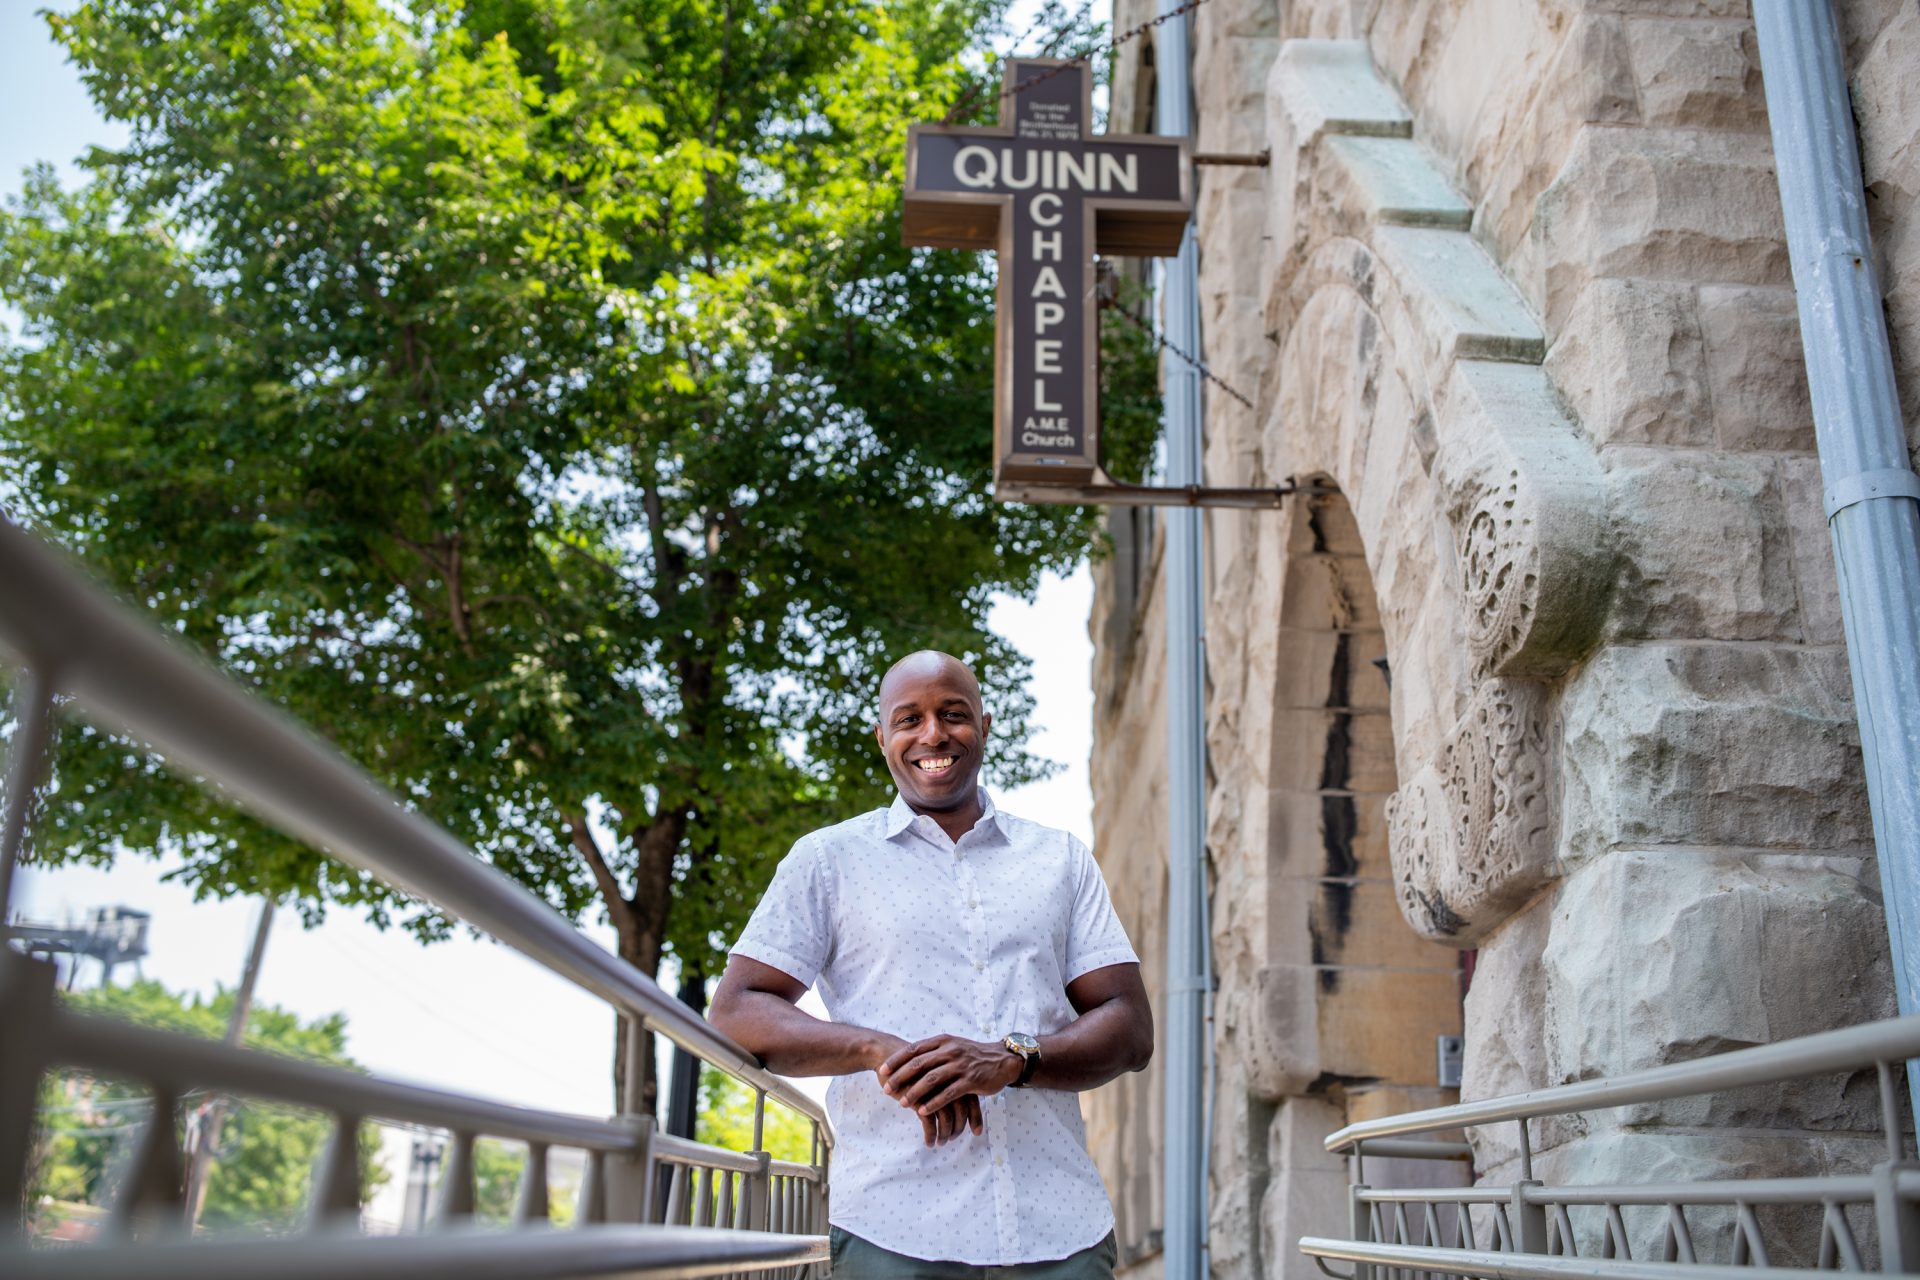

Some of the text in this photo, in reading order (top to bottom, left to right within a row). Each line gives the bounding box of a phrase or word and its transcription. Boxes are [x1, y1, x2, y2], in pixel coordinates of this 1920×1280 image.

[1029, 101, 1071, 113] Donated
[953, 145, 1139, 192] QUINN
[1030, 193, 1066, 412] CHAPEL
[1021, 431, 1075, 448] Church
